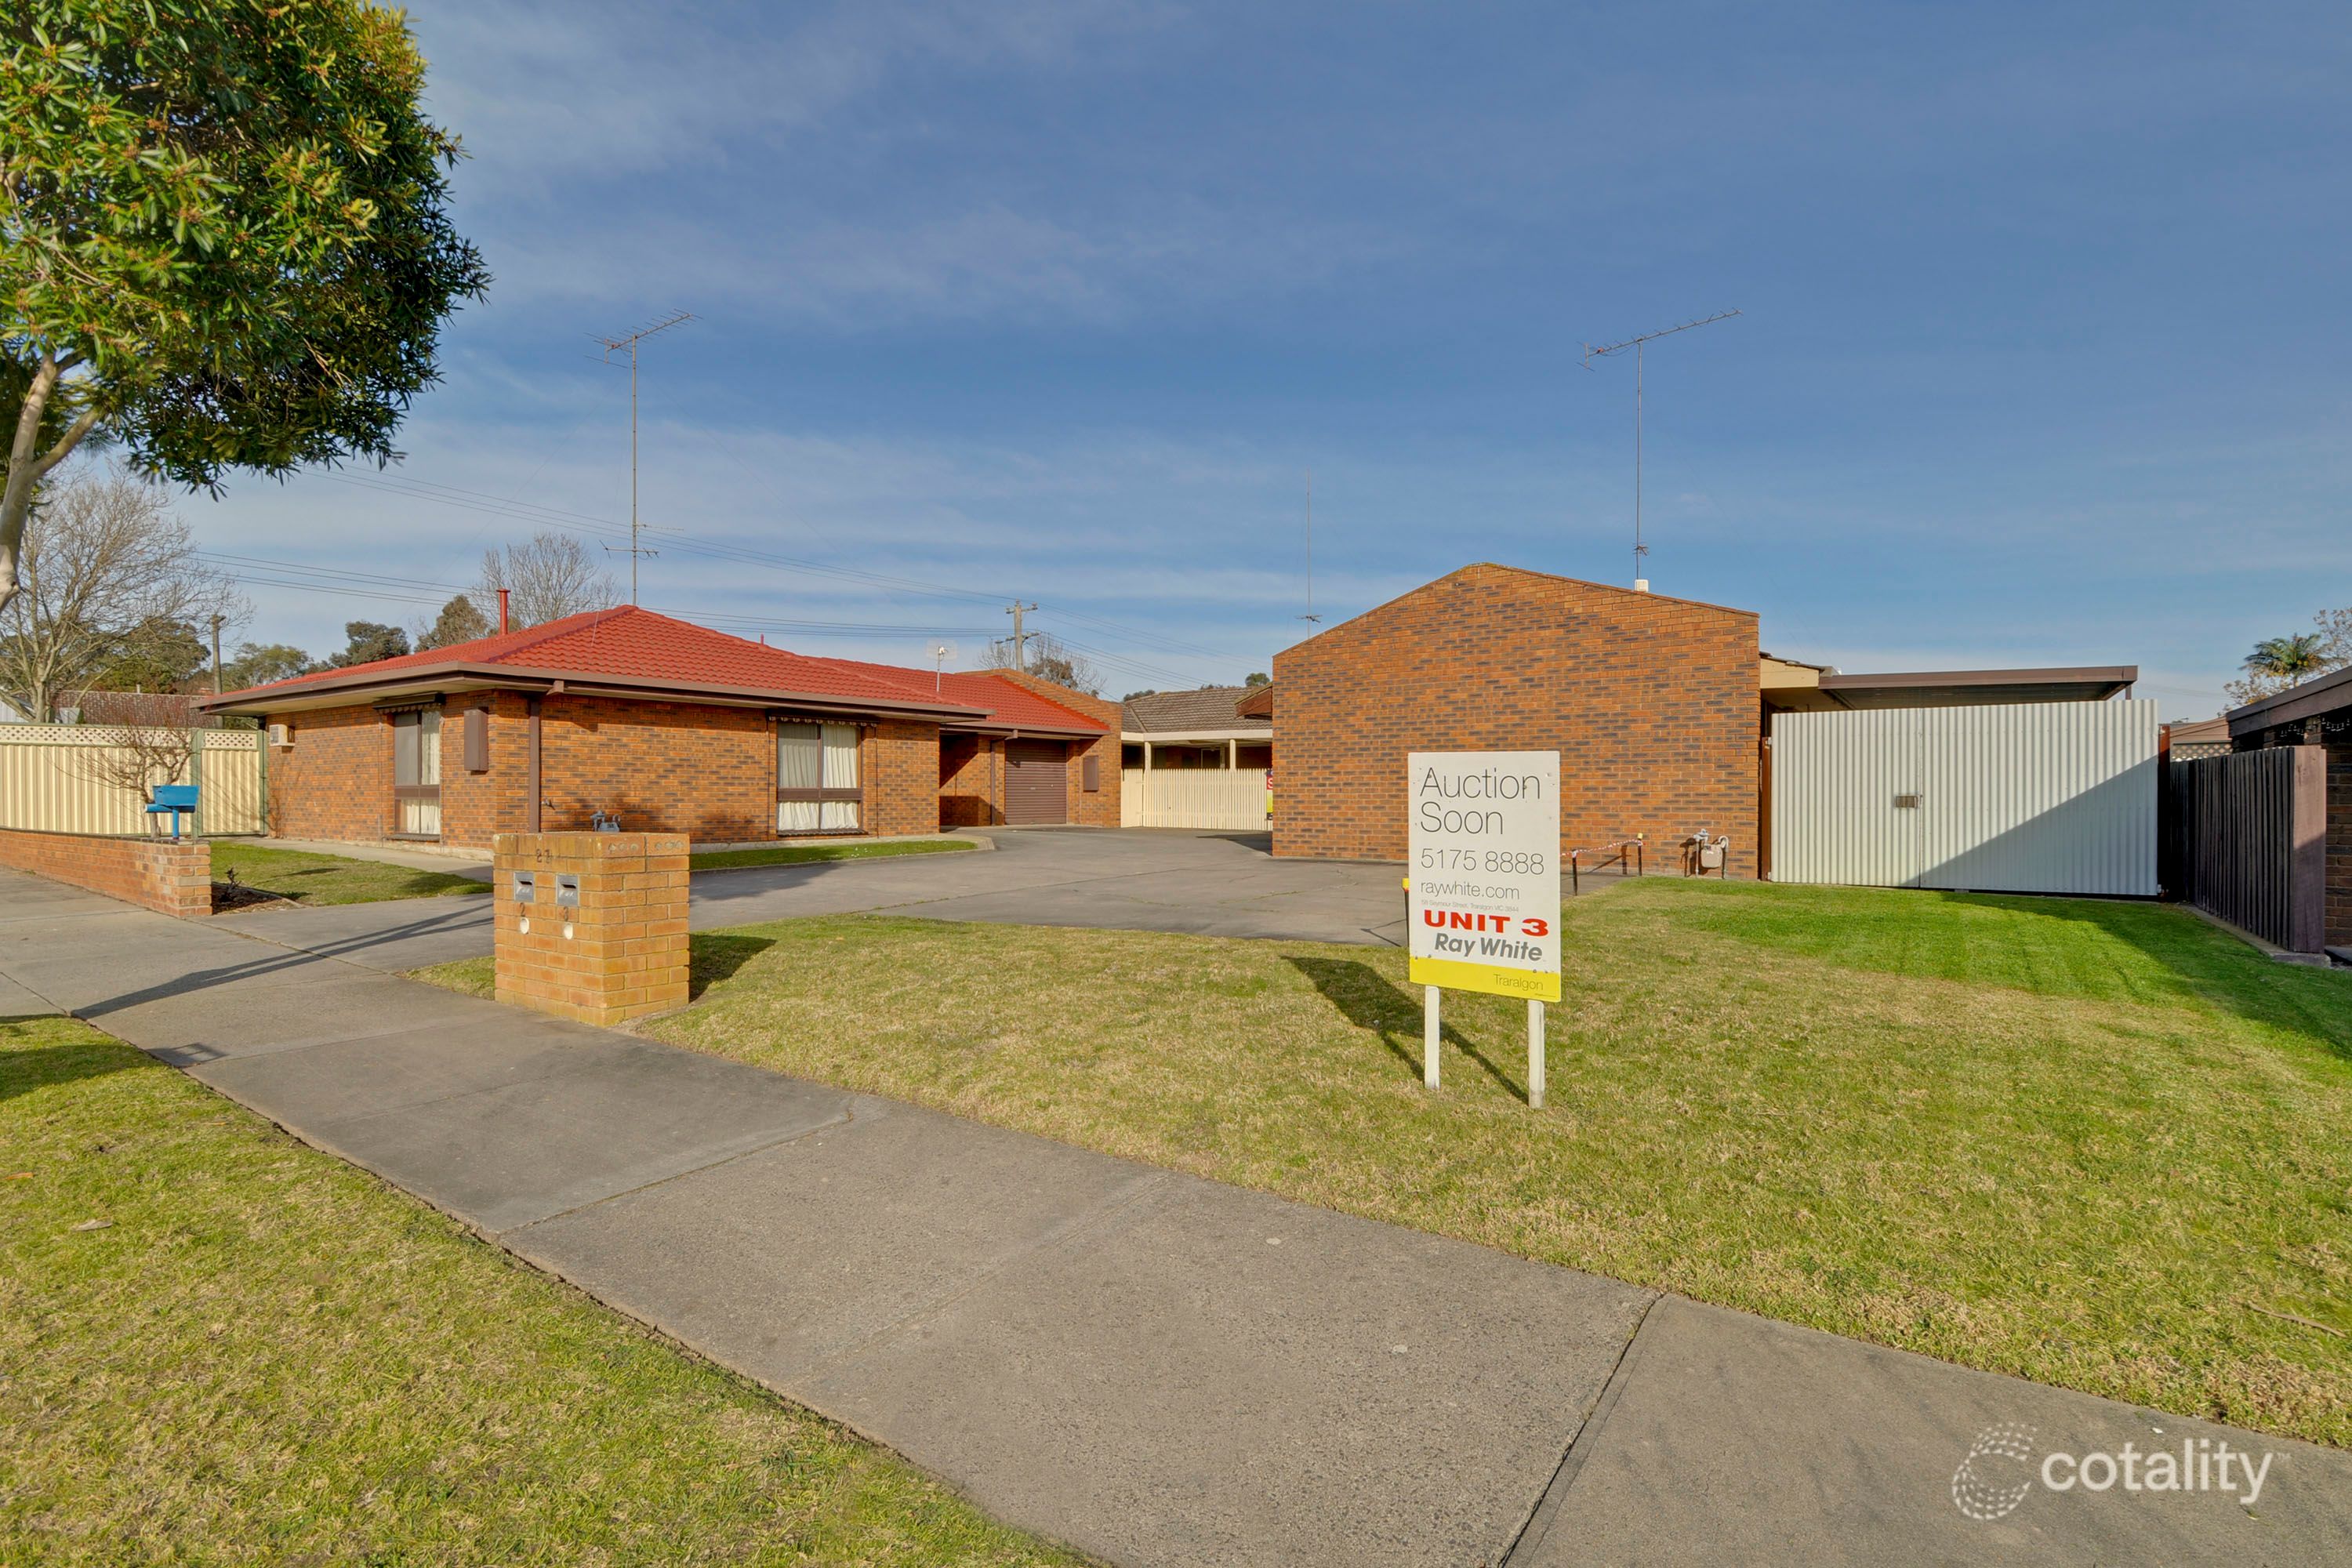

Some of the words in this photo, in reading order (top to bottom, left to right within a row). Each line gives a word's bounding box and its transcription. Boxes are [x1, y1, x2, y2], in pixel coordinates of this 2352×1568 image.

[1420, 767, 1541, 800] Auction
[1421, 801, 1503, 835] Soon
[1421, 848, 1476, 871] 5175
[1485, 851, 1544, 876] 8888
[1421, 880, 1519, 900] raywhite.com
[520, 902, 526, 916] 2
[1424, 909, 1511, 934] UNIT
[1521, 918, 1549, 937] 3
[1435, 932, 1476, 957] Ray
[1479, 937, 1543, 962] White
[1494, 973, 1544, 992] Traralgon
